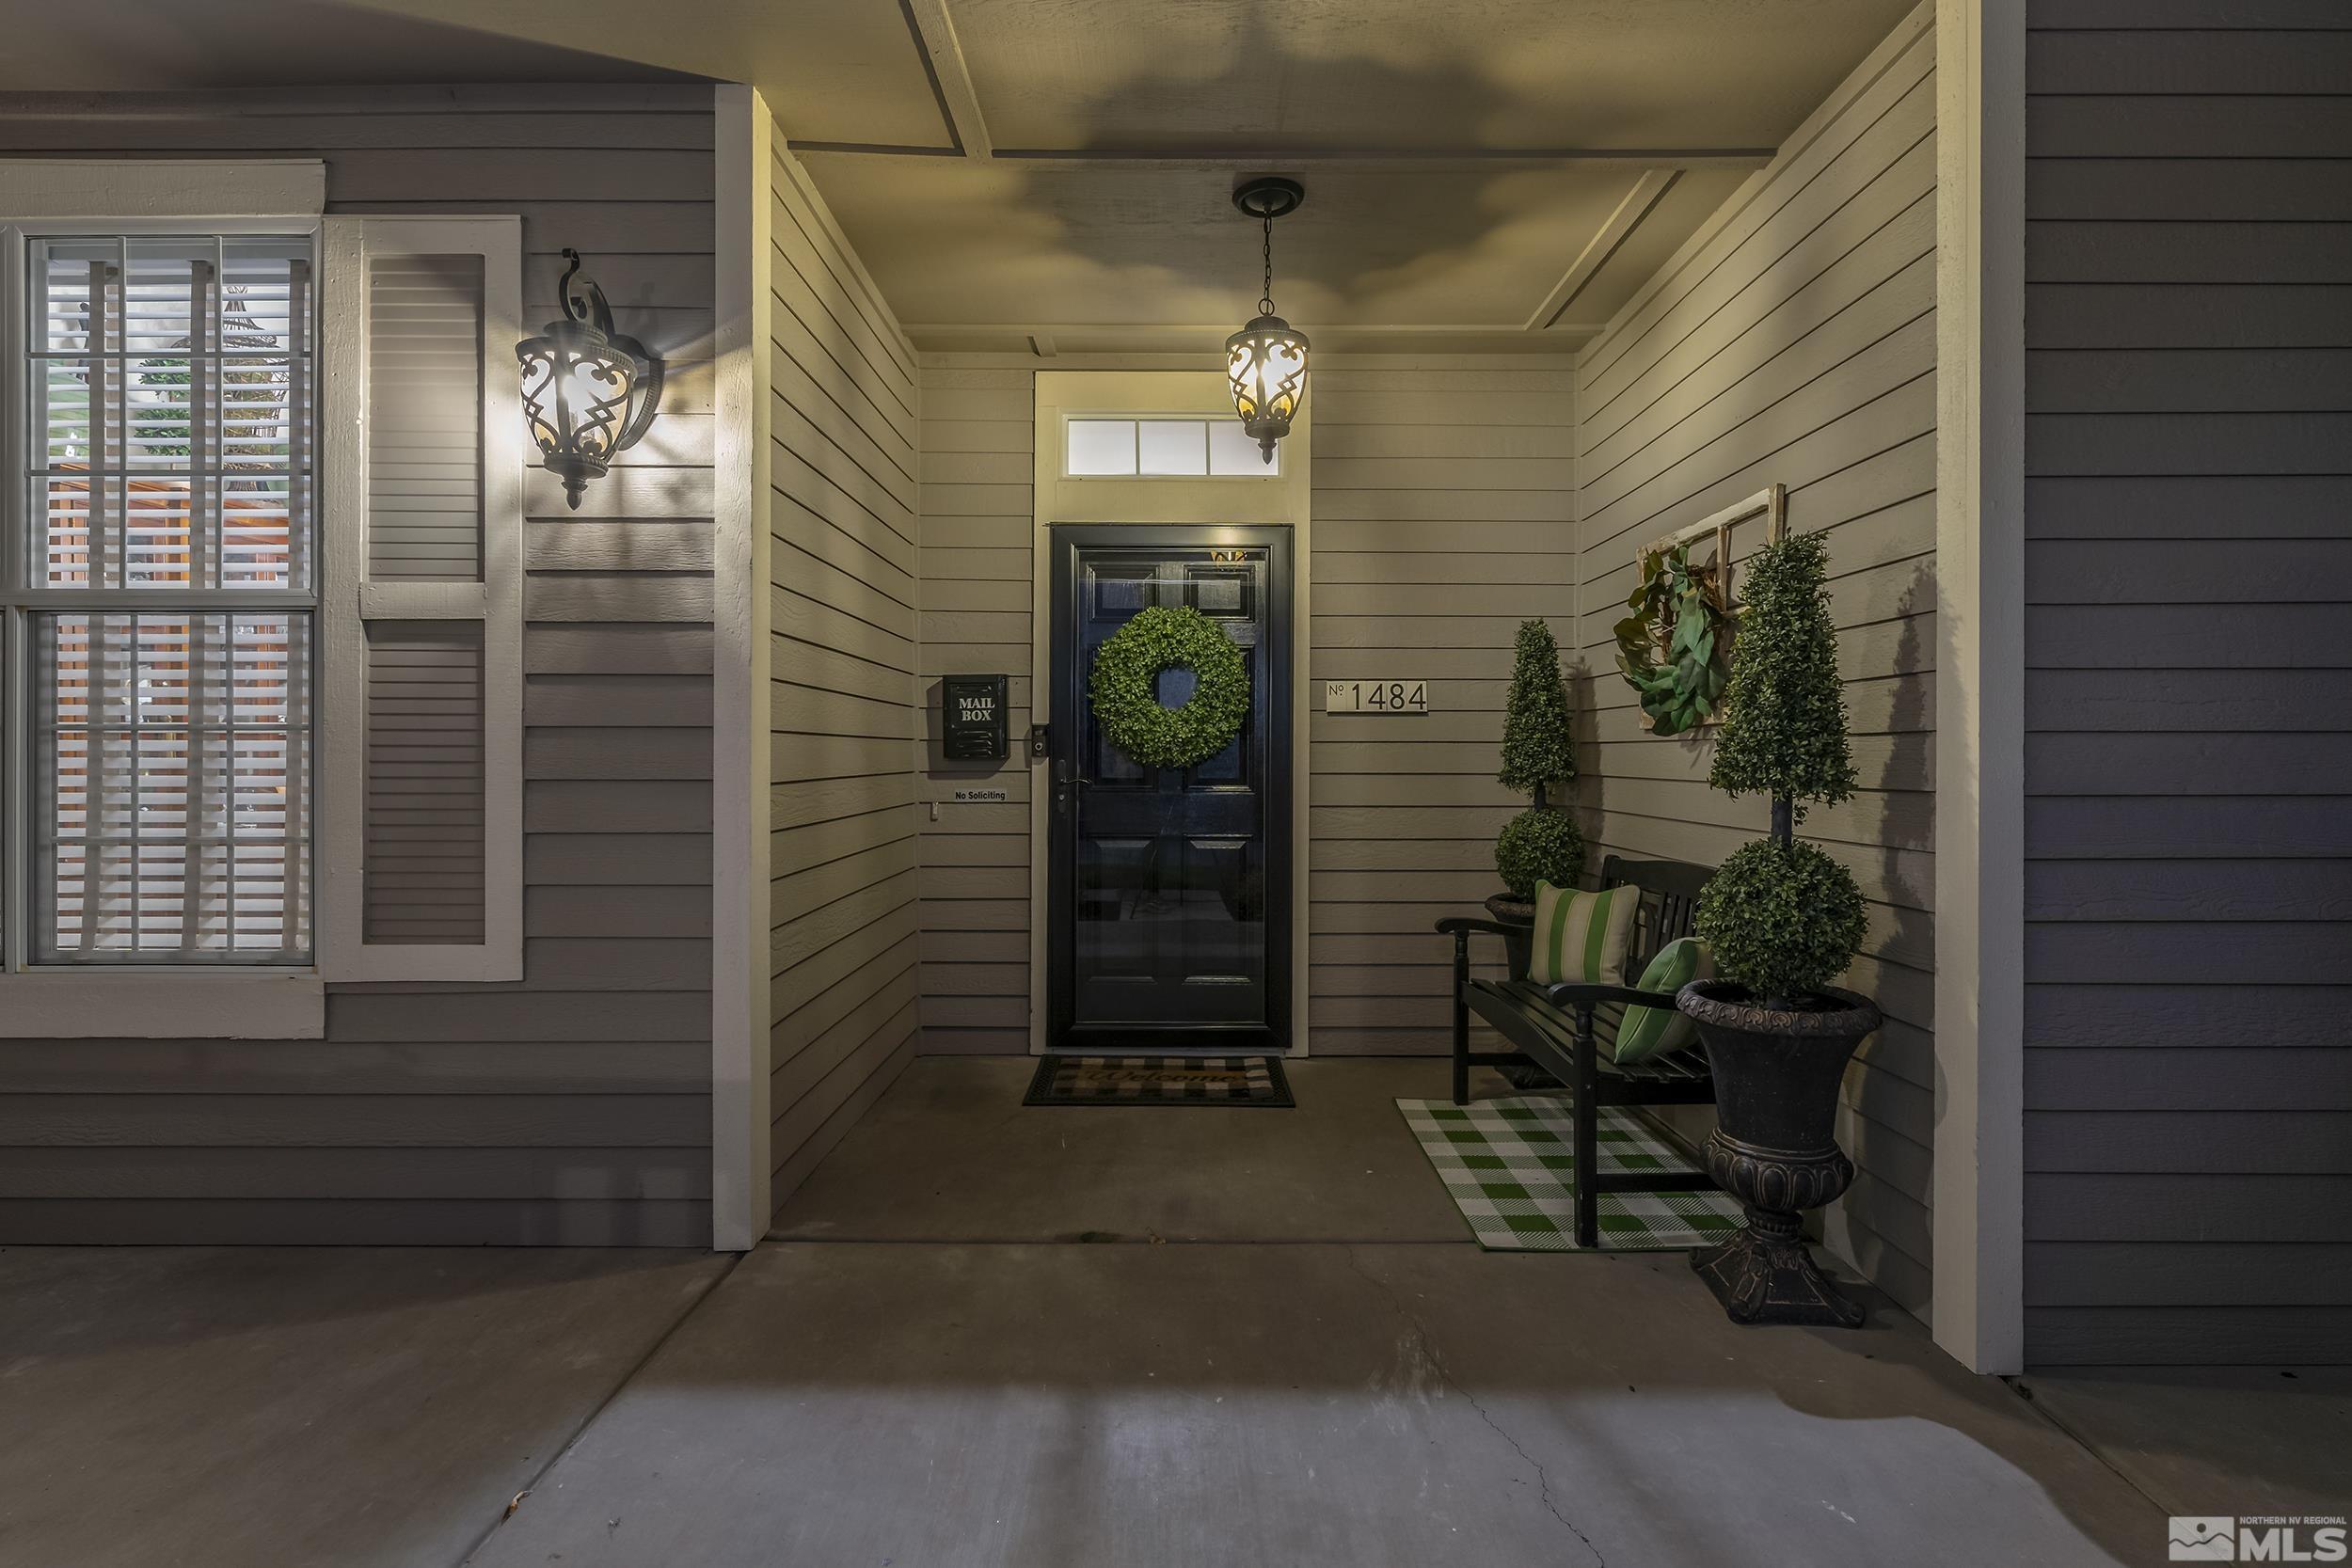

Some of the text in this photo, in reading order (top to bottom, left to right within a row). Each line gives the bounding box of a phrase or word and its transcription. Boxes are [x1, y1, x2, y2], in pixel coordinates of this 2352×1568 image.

[1352, 683, 1426, 710] 1484
[959, 697, 995, 709] MAIL
[961, 709, 992, 721] BOX
[955, 791, 1006, 800] No Soliciting
[1084, 1069, 1240, 1083] Welcome
